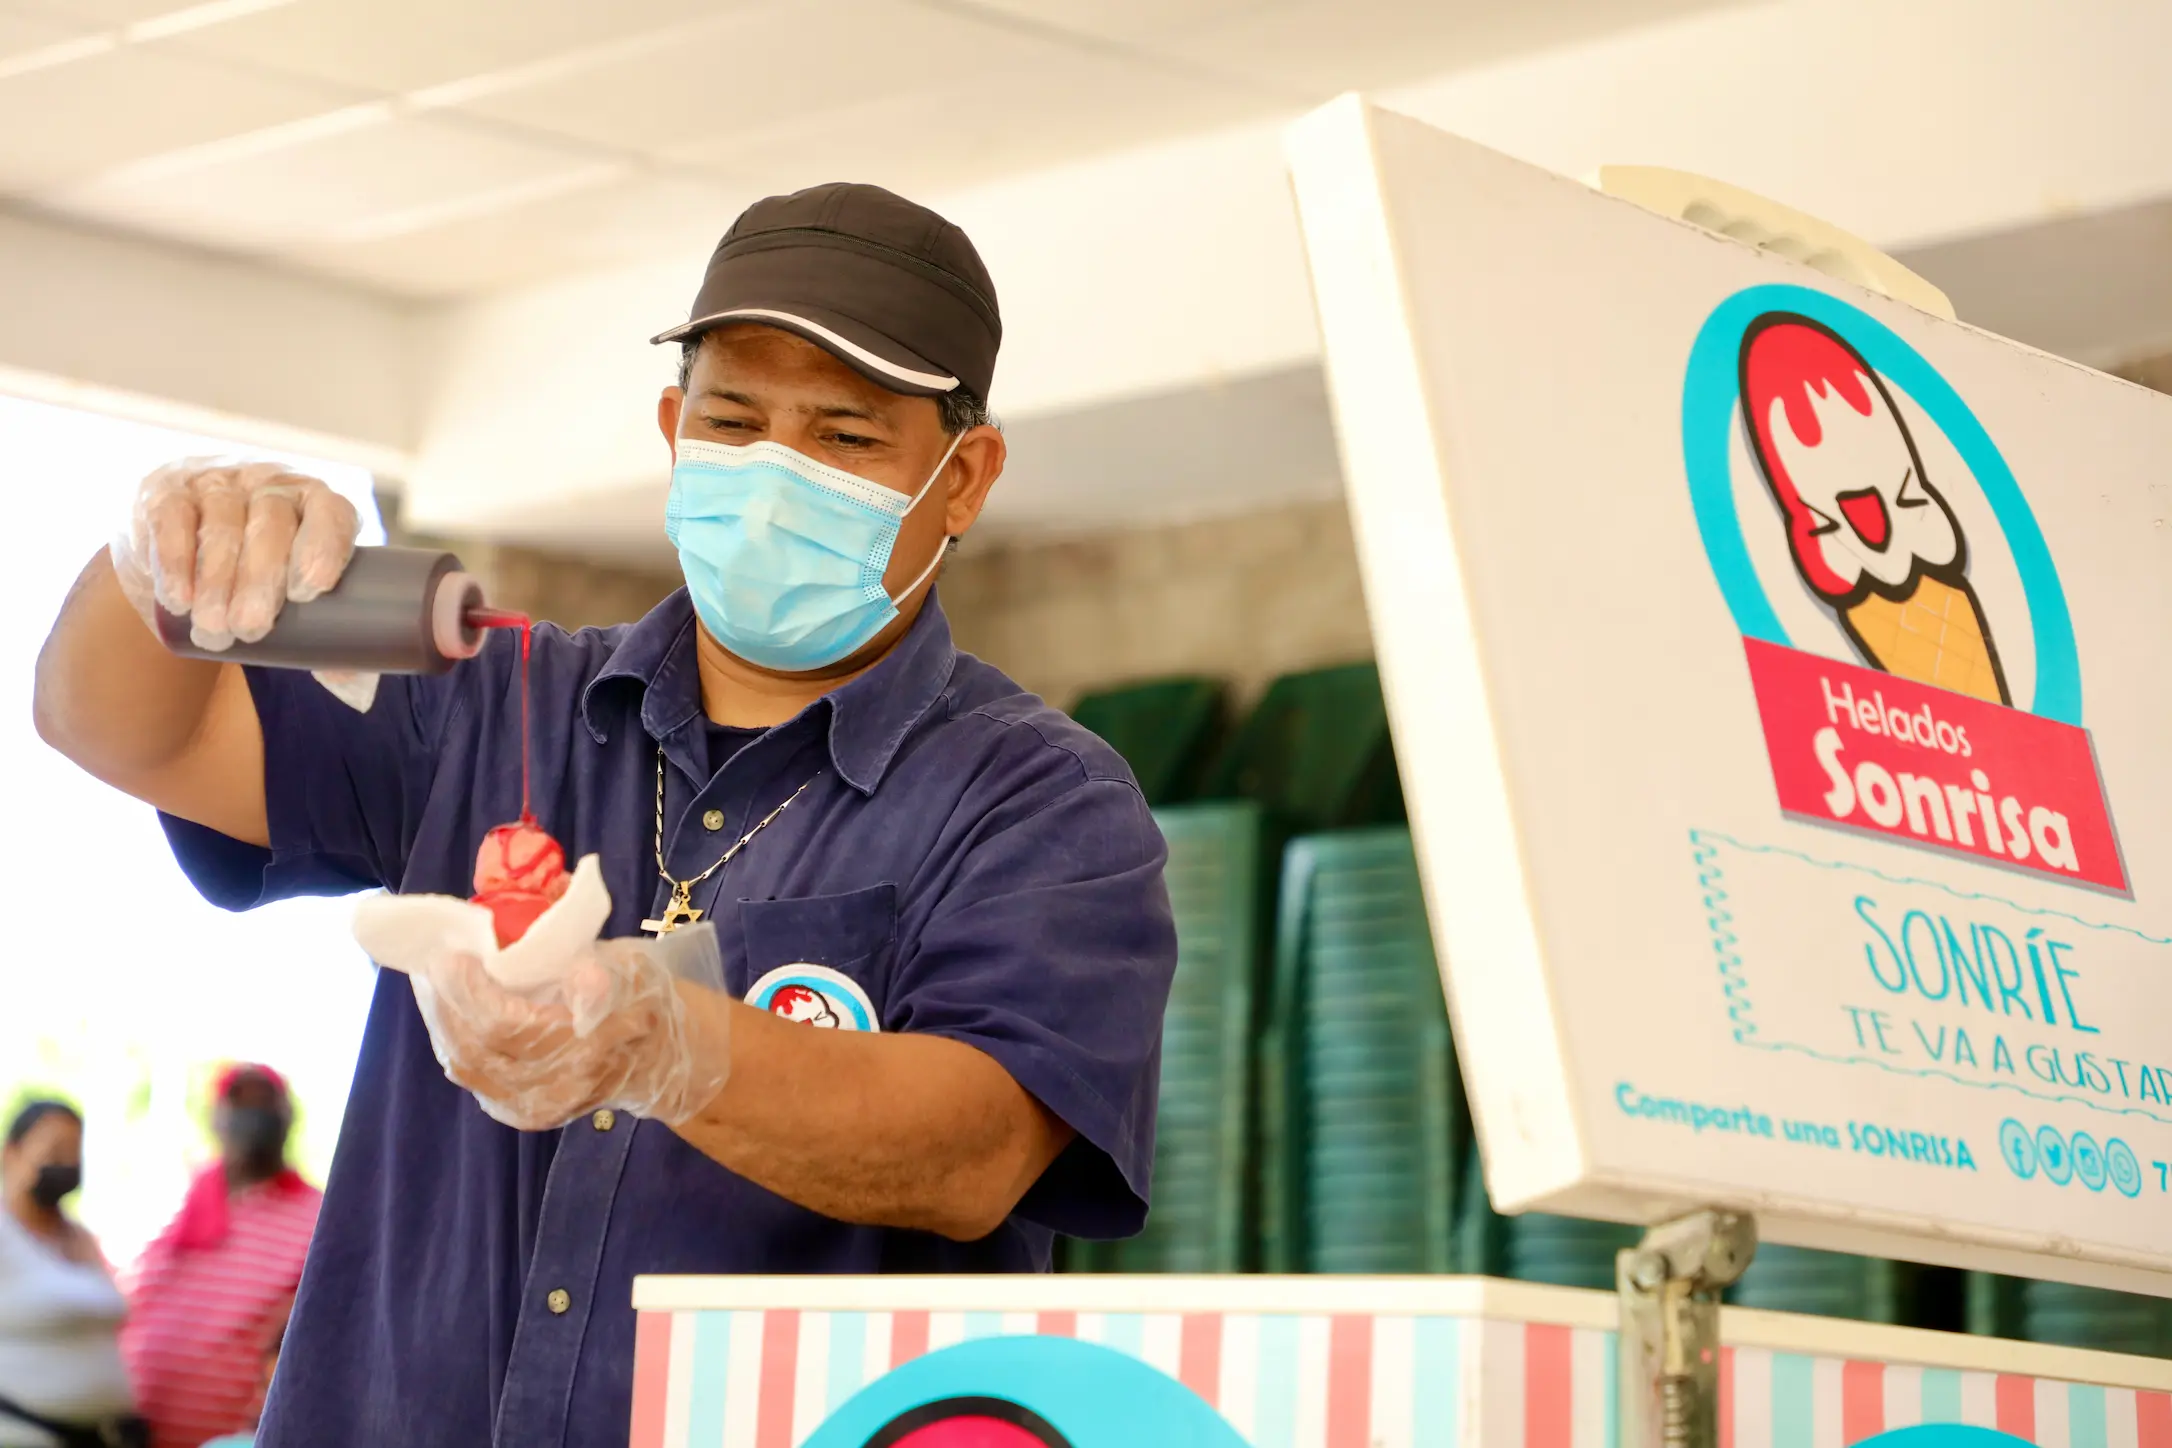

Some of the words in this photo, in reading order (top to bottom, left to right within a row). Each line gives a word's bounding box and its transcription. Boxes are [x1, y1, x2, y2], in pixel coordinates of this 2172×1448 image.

[1820, 676, 1972, 757] Helados
[1813, 727, 2080, 872] Sonrisa
[1854, 895, 2101, 1034] SONRÍE
[1840, 1004, 1903, 1055] TE
[1911, 1020, 1978, 1069] VA
[1992, 1034, 2016, 1075] A
[1614, 1081, 1774, 1138] Comparte
[1782, 1118, 1842, 1150] una
[1847, 1119, 1978, 1172] SONRISA
